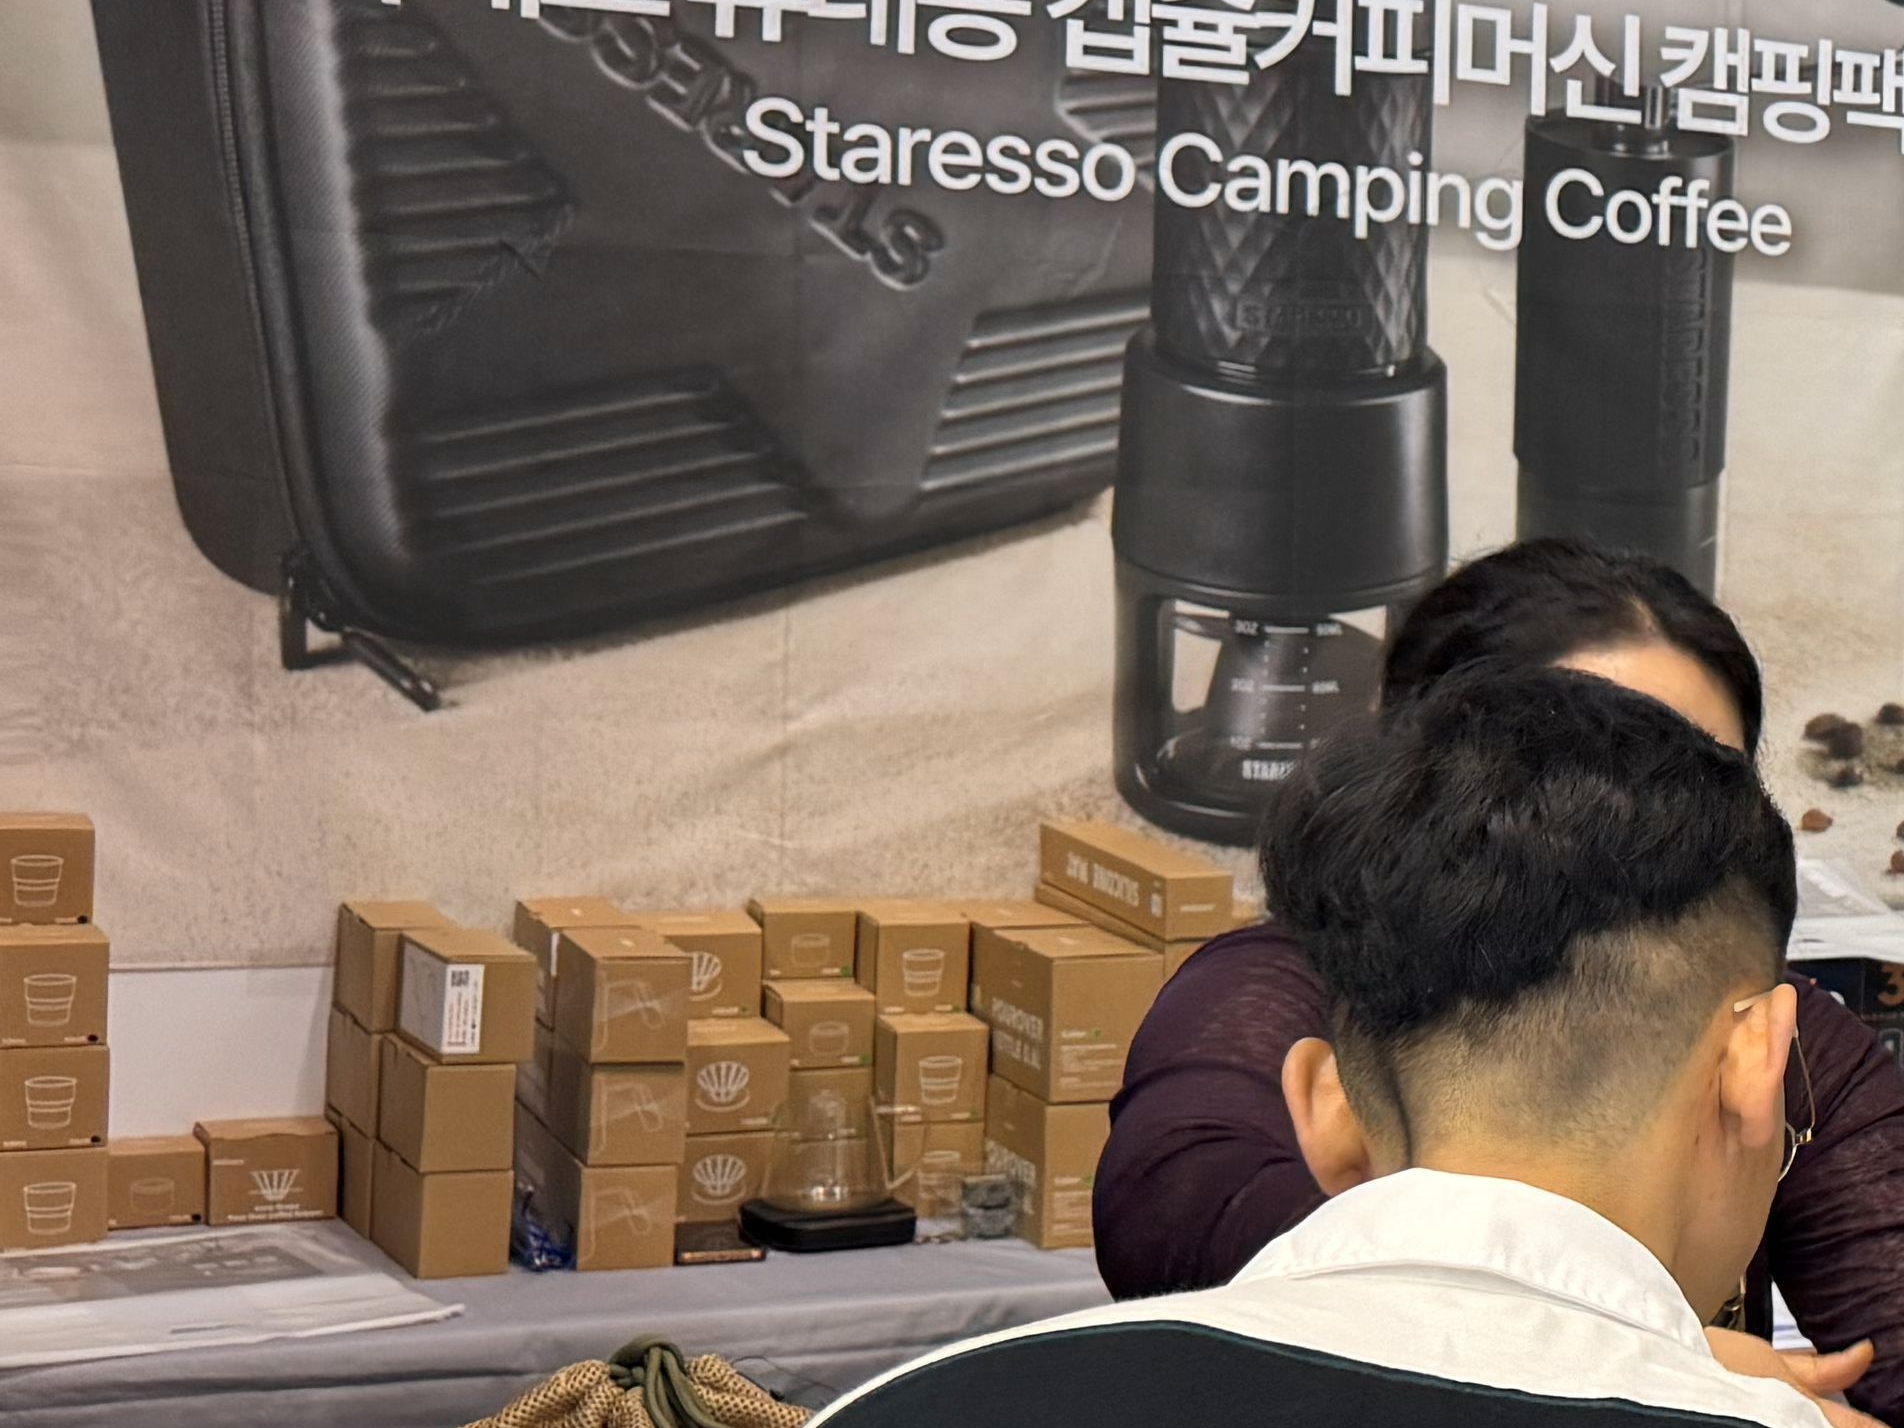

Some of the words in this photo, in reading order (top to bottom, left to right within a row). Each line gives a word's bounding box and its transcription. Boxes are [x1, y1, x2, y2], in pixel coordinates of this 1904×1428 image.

[743, 97, 1136, 203] Staresso
[1158, 135, 1523, 250] Camping
[1543, 163, 1793, 258] Coffee
